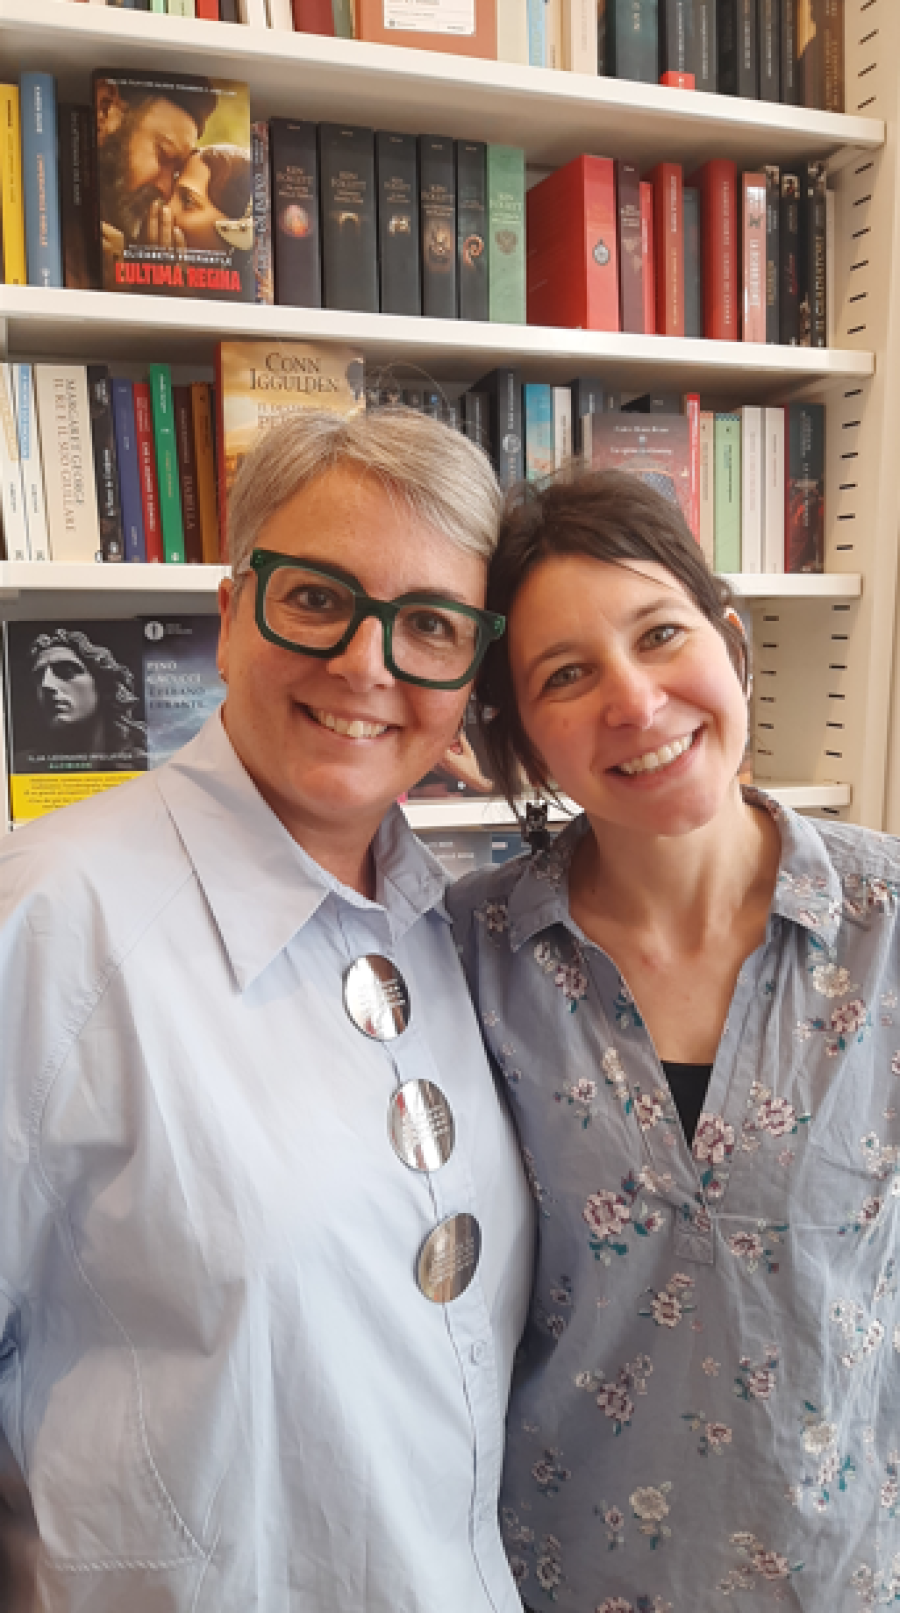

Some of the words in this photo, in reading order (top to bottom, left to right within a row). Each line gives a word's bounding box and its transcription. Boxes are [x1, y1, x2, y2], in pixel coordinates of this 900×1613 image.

[186, 265, 242, 293] REGINA
[265, 352, 321, 374] CONN
[249, 368, 340, 395] IGGULDEN
[65, 378, 80, 452] MARGARET
[71, 454, 85, 508] GEORGE
